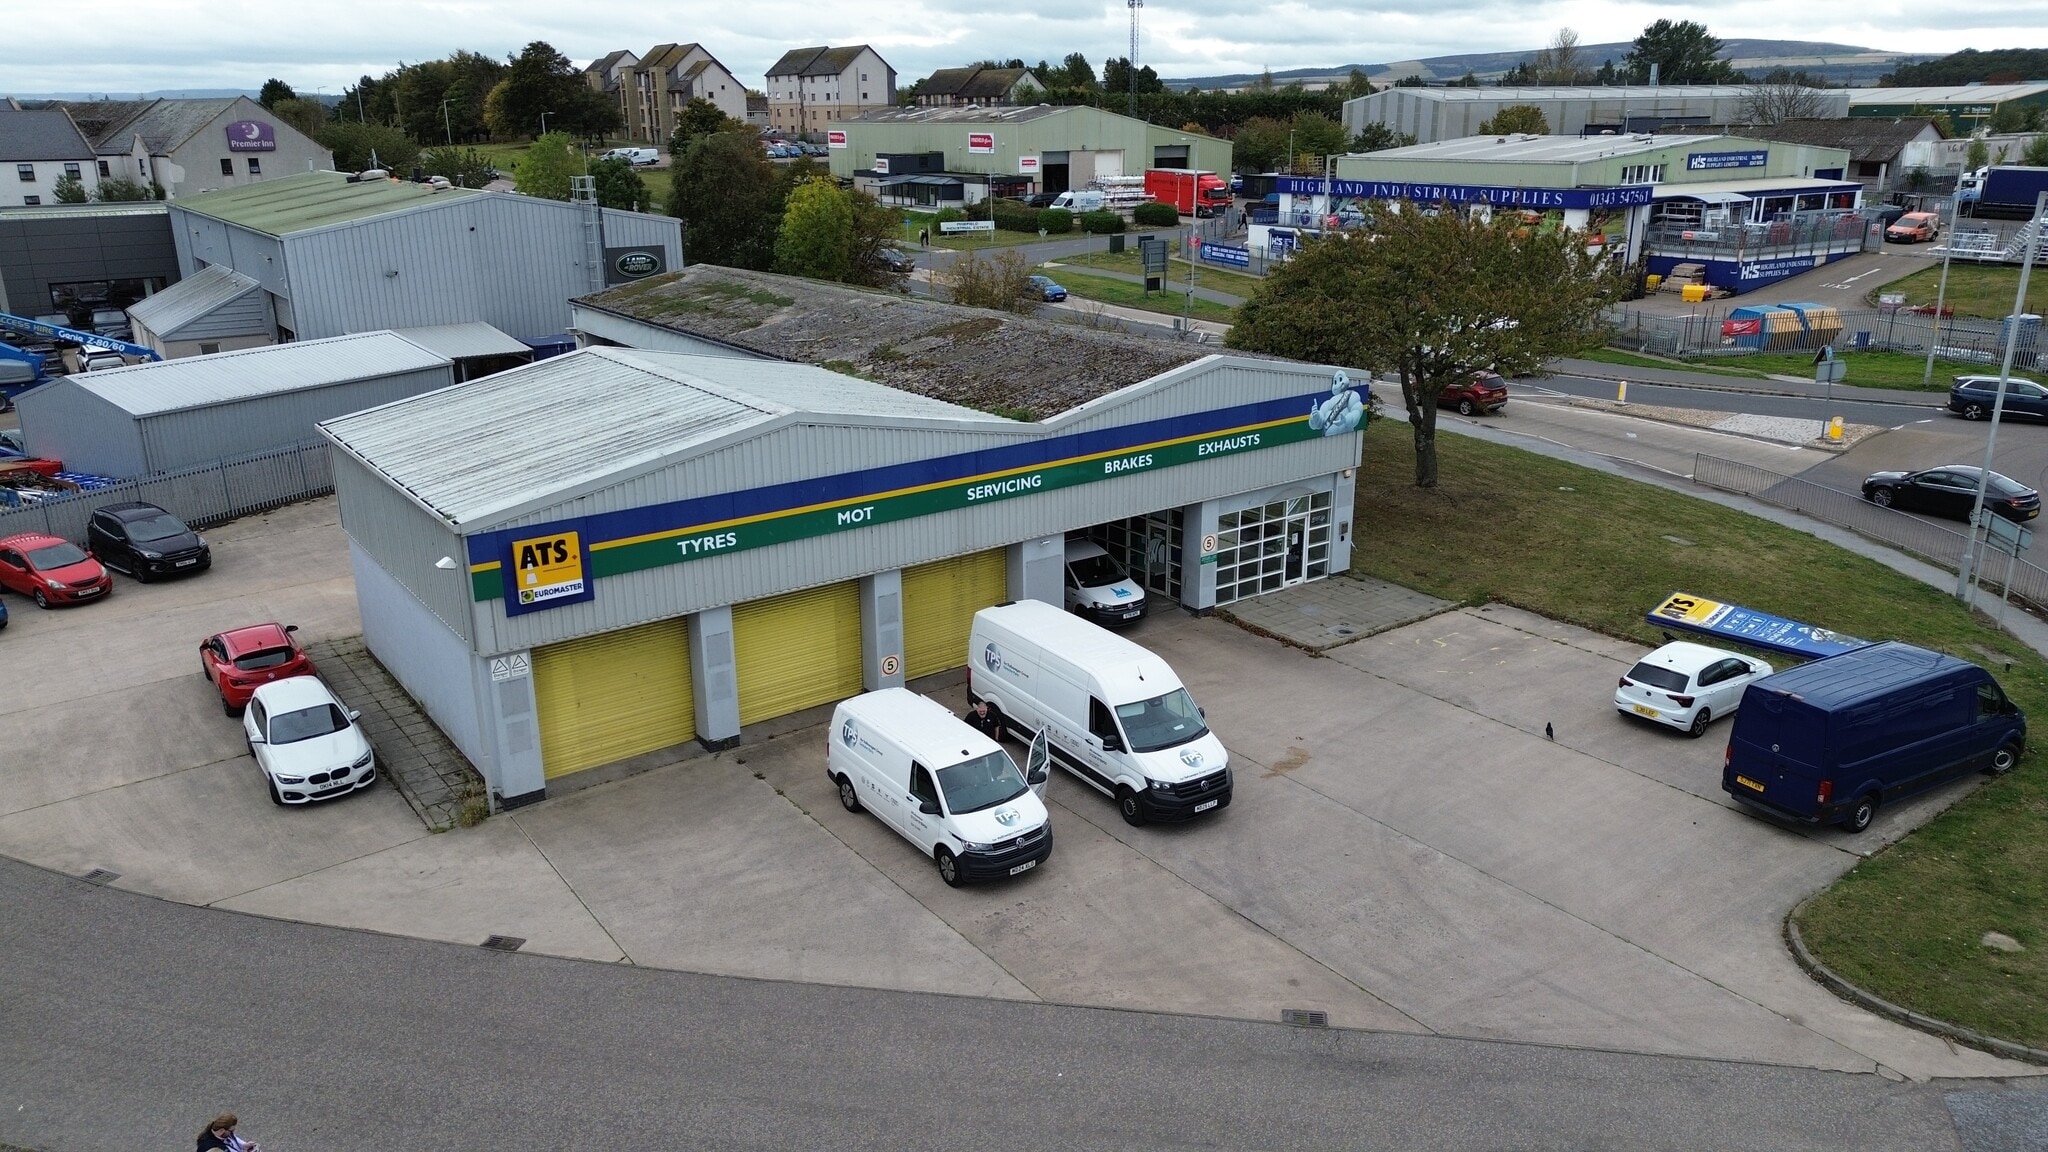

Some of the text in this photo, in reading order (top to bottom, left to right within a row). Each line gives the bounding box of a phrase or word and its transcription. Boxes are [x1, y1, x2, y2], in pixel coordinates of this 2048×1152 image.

[1291, 180, 1648, 206] HIGHLAND INDUSTRIAL SUPPLIES 01343 547561
[626, 256, 646, 264] LAND
[1760, 262, 1786, 270] HIGHLAND
[1786, 260, 1814, 268] INDUSTRIAL
[0, 317, 54, 334] CCESS HIRE
[58, 330, 126, 352] Genie Z-80/60
[1198, 434, 1260, 456] EXHAUSTS
[1104, 454, 1153, 474] BRAKES
[967, 474, 1042, 500] SERVICING
[837, 506, 874, 526] MOT
[677, 532, 737, 554] TYRES
[1206, 539, 1212, 548] 5
[520, 539, 568, 570] ATS
[534, 583, 582, 598] EUROMASTER
[1661, 598, 1694, 620] ATS
[888, 660, 894, 670] 5
[986, 649, 1000, 666] TPS
[844, 724, 858, 742] TPS
[1180, 750, 1202, 764] TPS
[996, 810, 1019, 822] TPS
